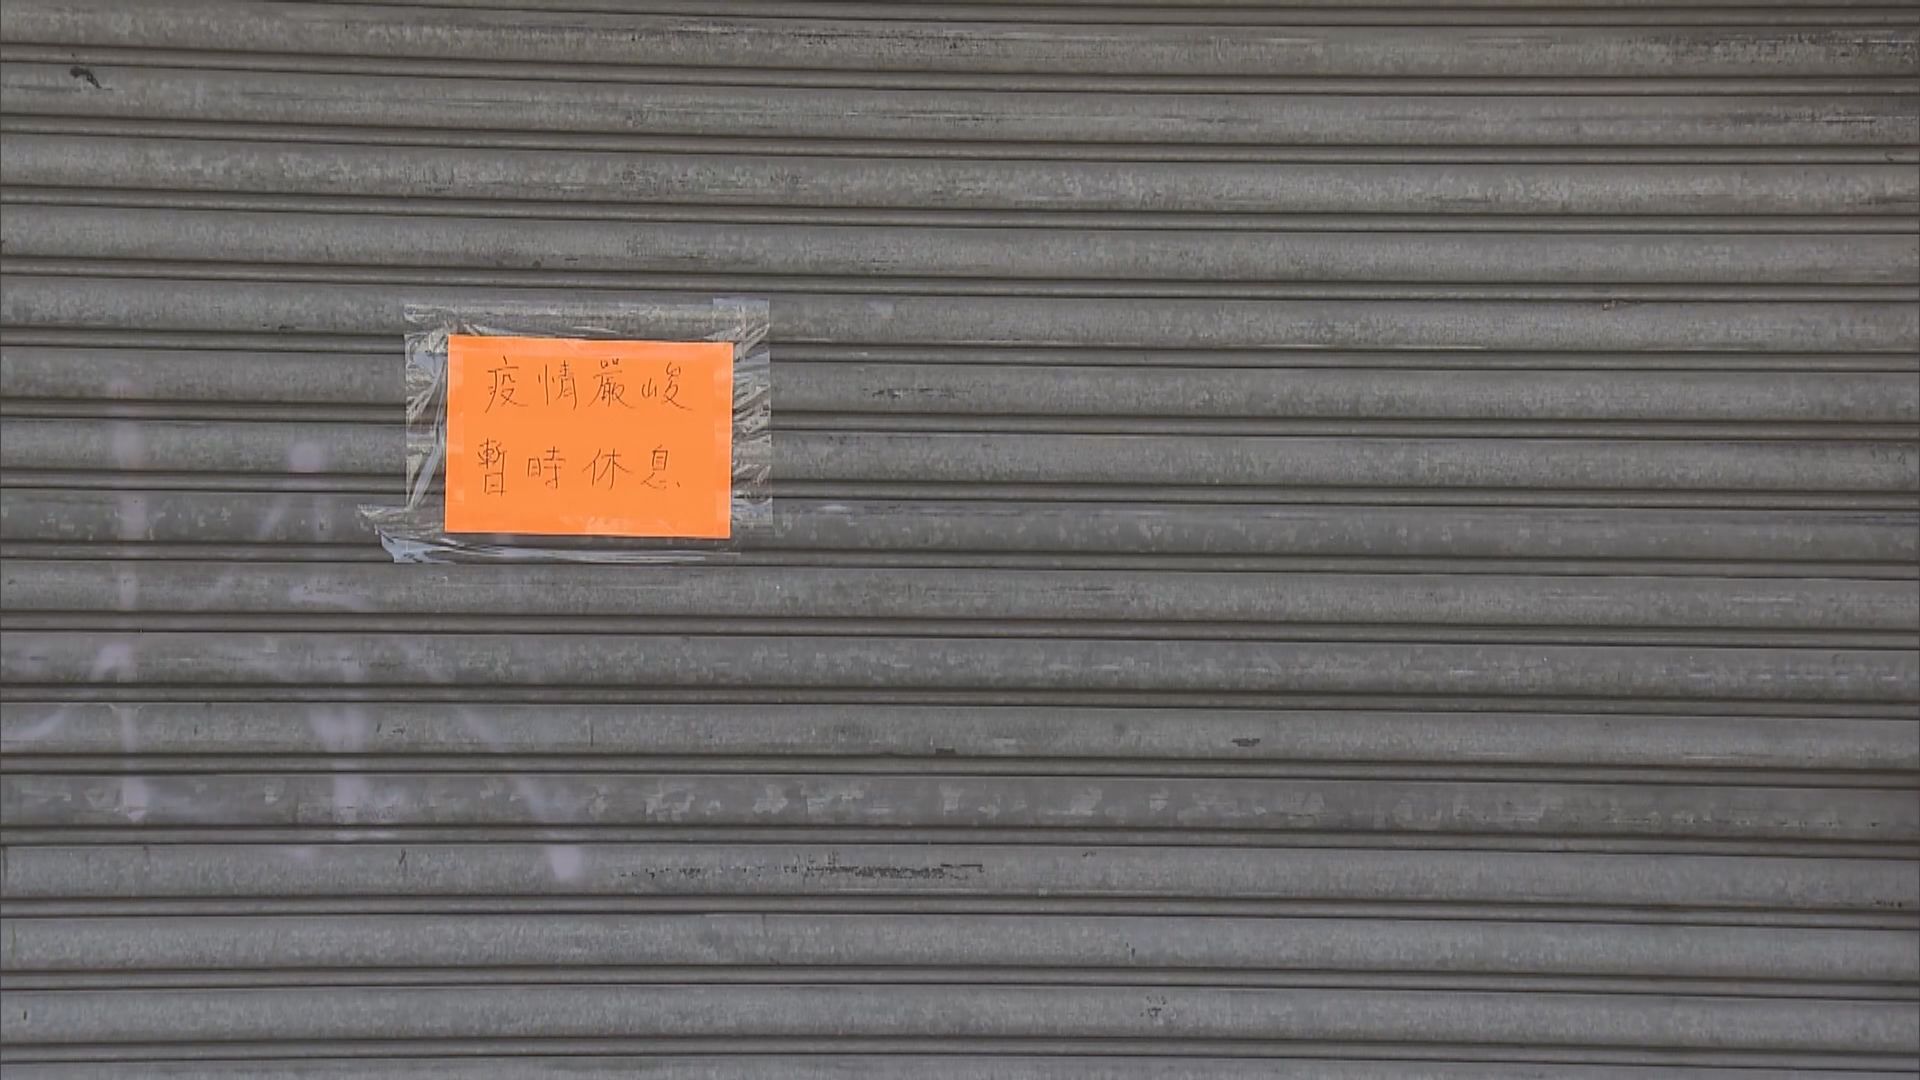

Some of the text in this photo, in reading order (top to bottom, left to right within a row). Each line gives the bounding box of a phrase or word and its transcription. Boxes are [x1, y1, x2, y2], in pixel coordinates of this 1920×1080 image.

[485, 355, 694, 413] 疫情嚴峻
[477, 437, 681, 496] 暫時休息
